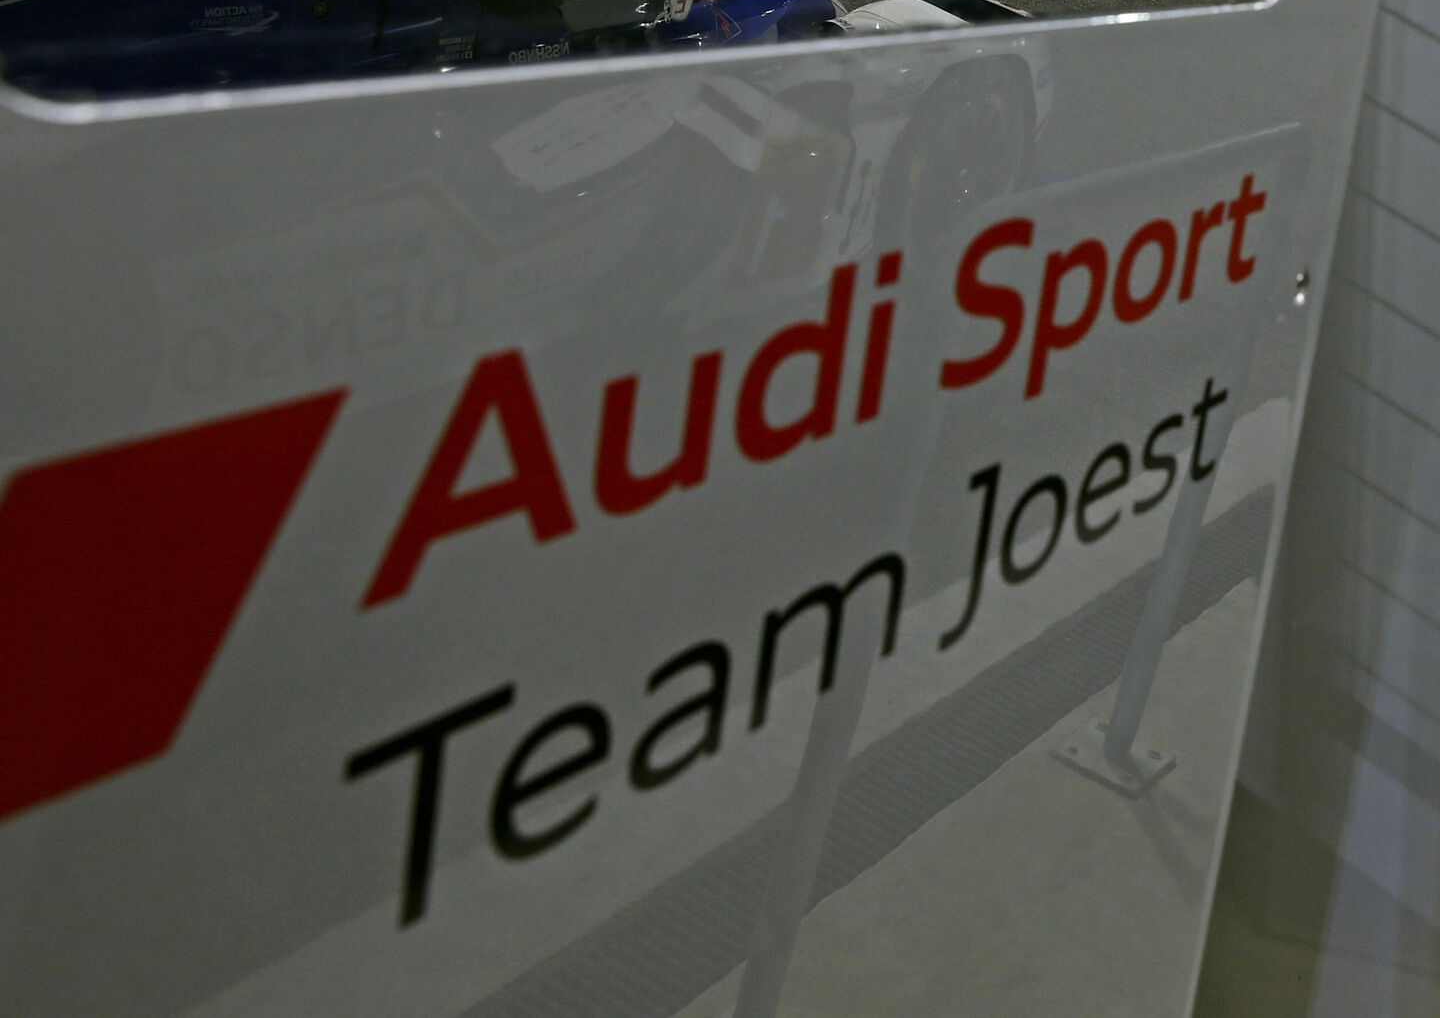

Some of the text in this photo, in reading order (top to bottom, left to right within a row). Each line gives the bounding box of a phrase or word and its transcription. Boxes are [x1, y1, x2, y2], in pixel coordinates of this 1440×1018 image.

[356, 174, 1266, 616] Audi Sport
[342, 376, 1230, 933] Team Joest
